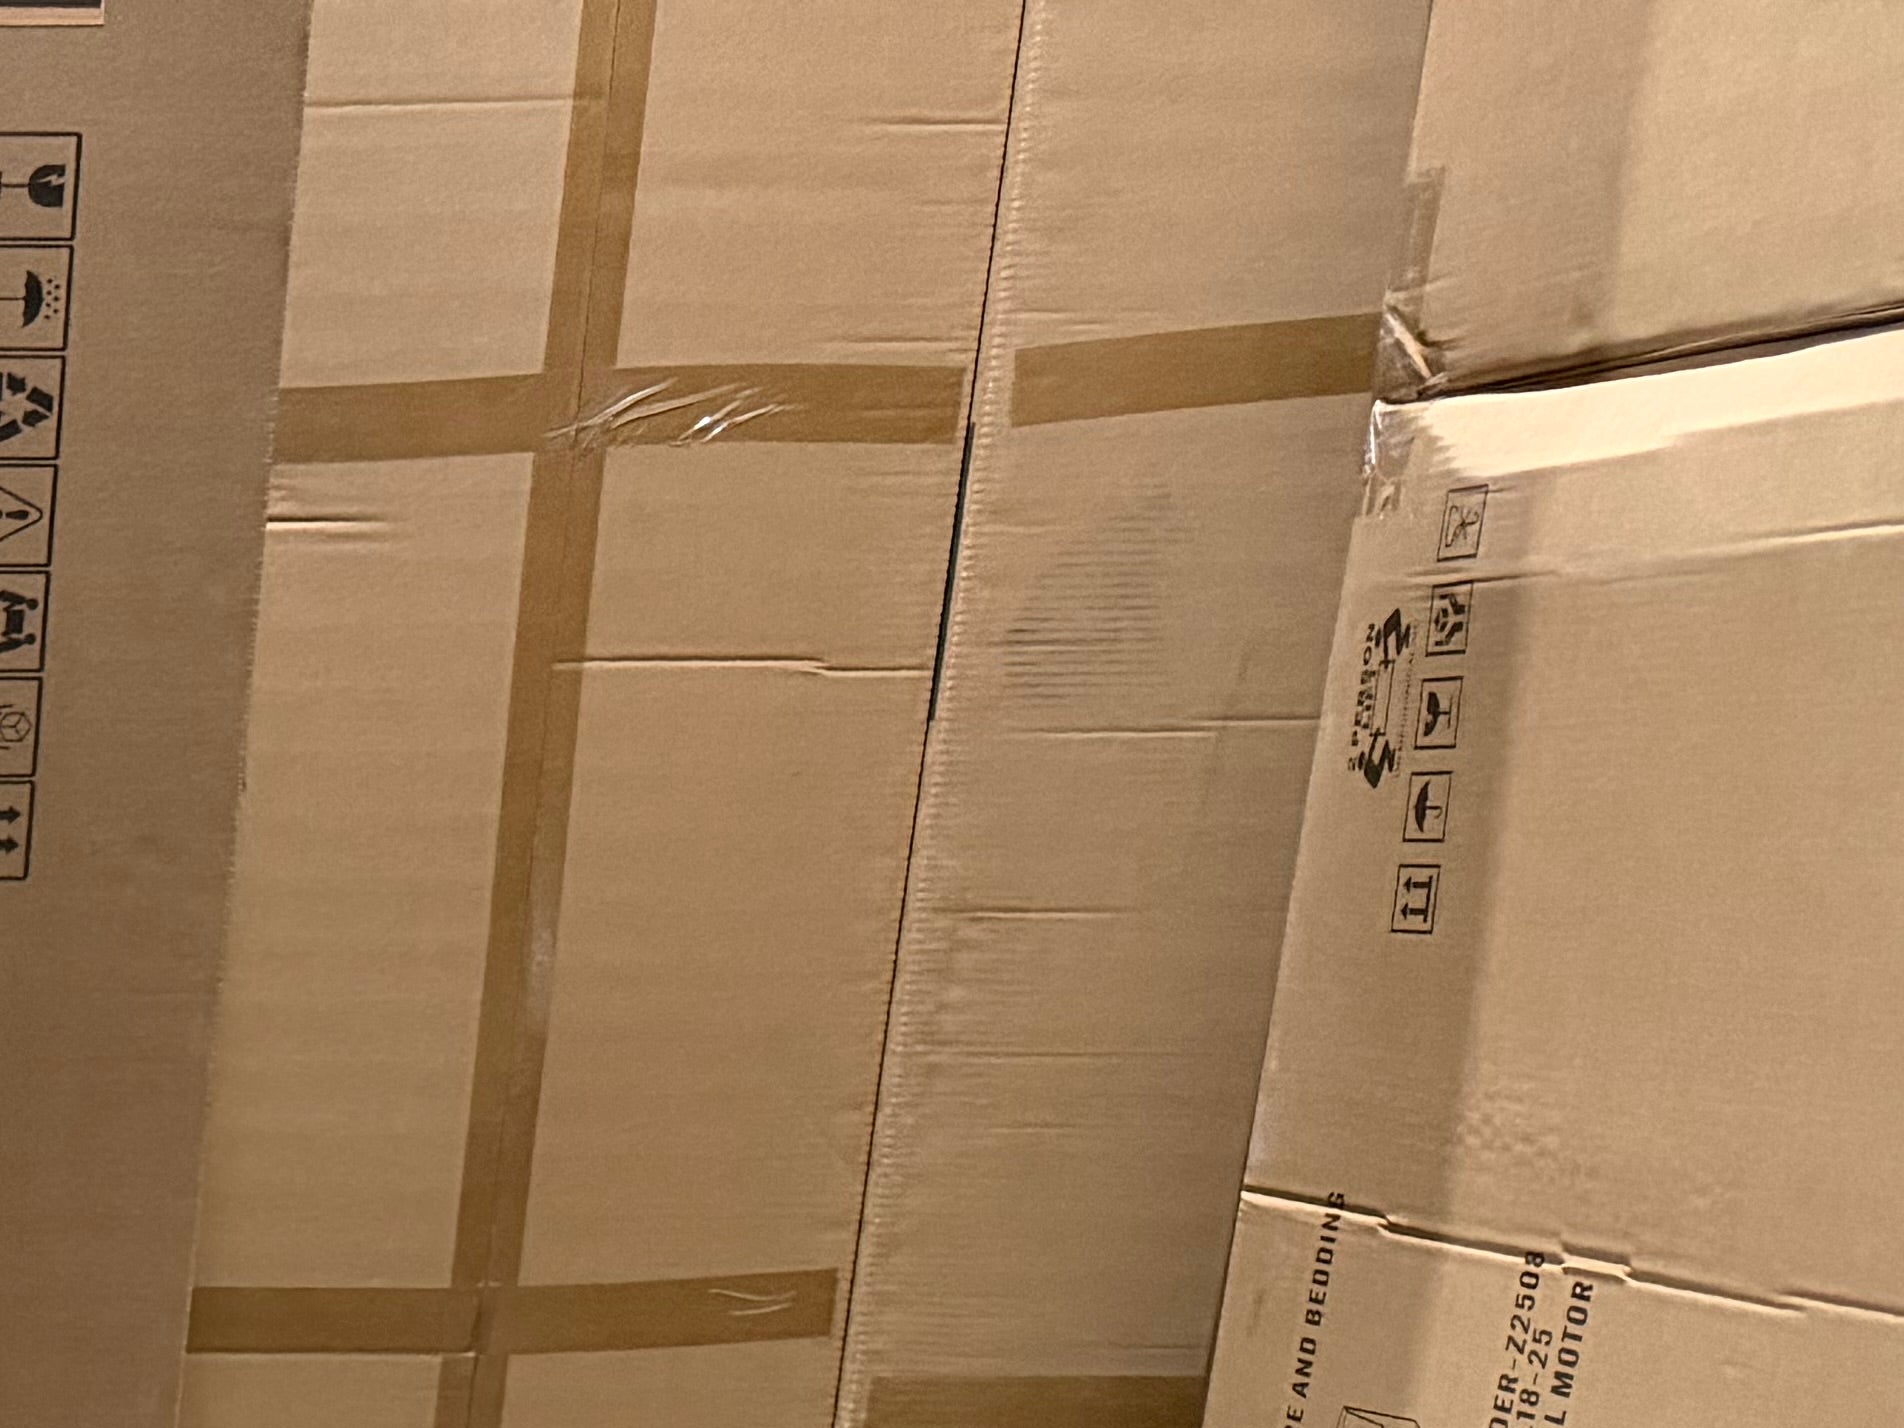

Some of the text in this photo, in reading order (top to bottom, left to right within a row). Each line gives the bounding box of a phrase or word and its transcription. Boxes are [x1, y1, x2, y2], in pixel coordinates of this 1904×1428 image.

[1291, 1337, 1317, 1399] AND
[1305, 1191, 1345, 1327] BEDDING
[1550, 1280, 1593, 1399] MOTOR
